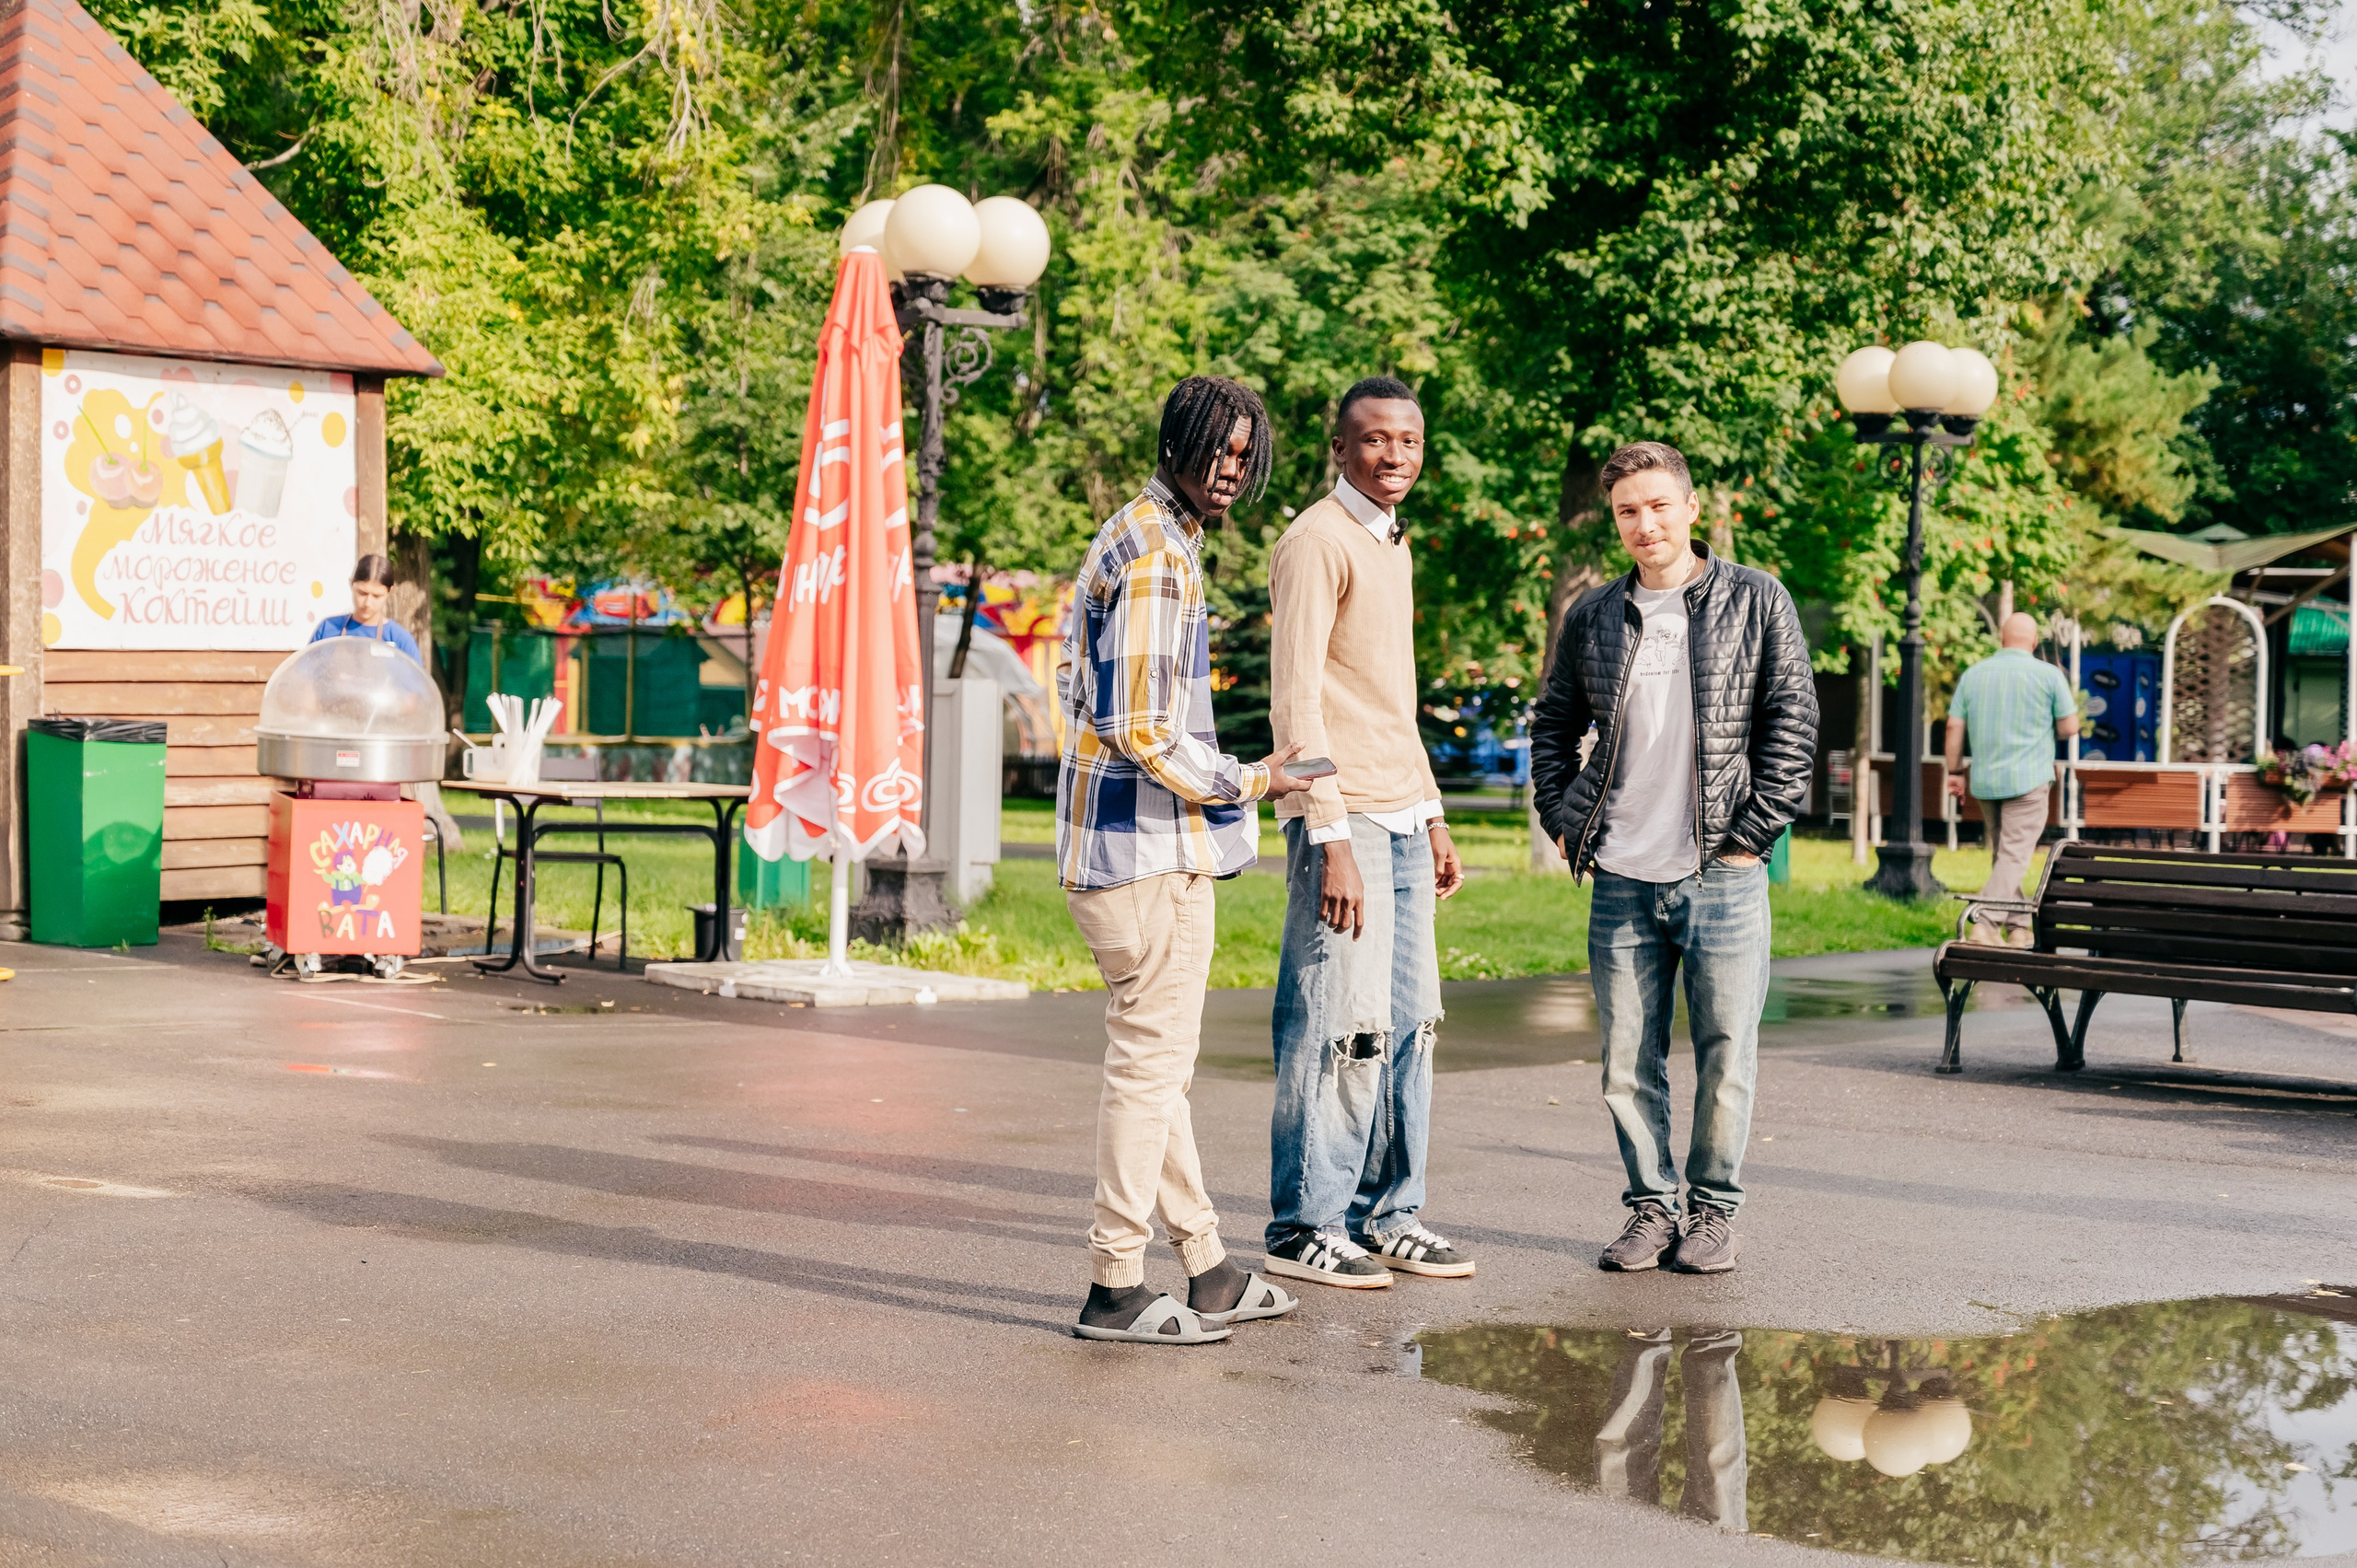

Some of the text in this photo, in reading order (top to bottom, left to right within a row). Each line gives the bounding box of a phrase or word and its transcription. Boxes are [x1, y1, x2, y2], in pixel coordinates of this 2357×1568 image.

[142, 512, 276, 548] Мягкое
[103, 554, 296, 590] мороженое
[309, 820, 409, 870] САХАРНАЯ
[319, 910, 395, 941] ВАТА
